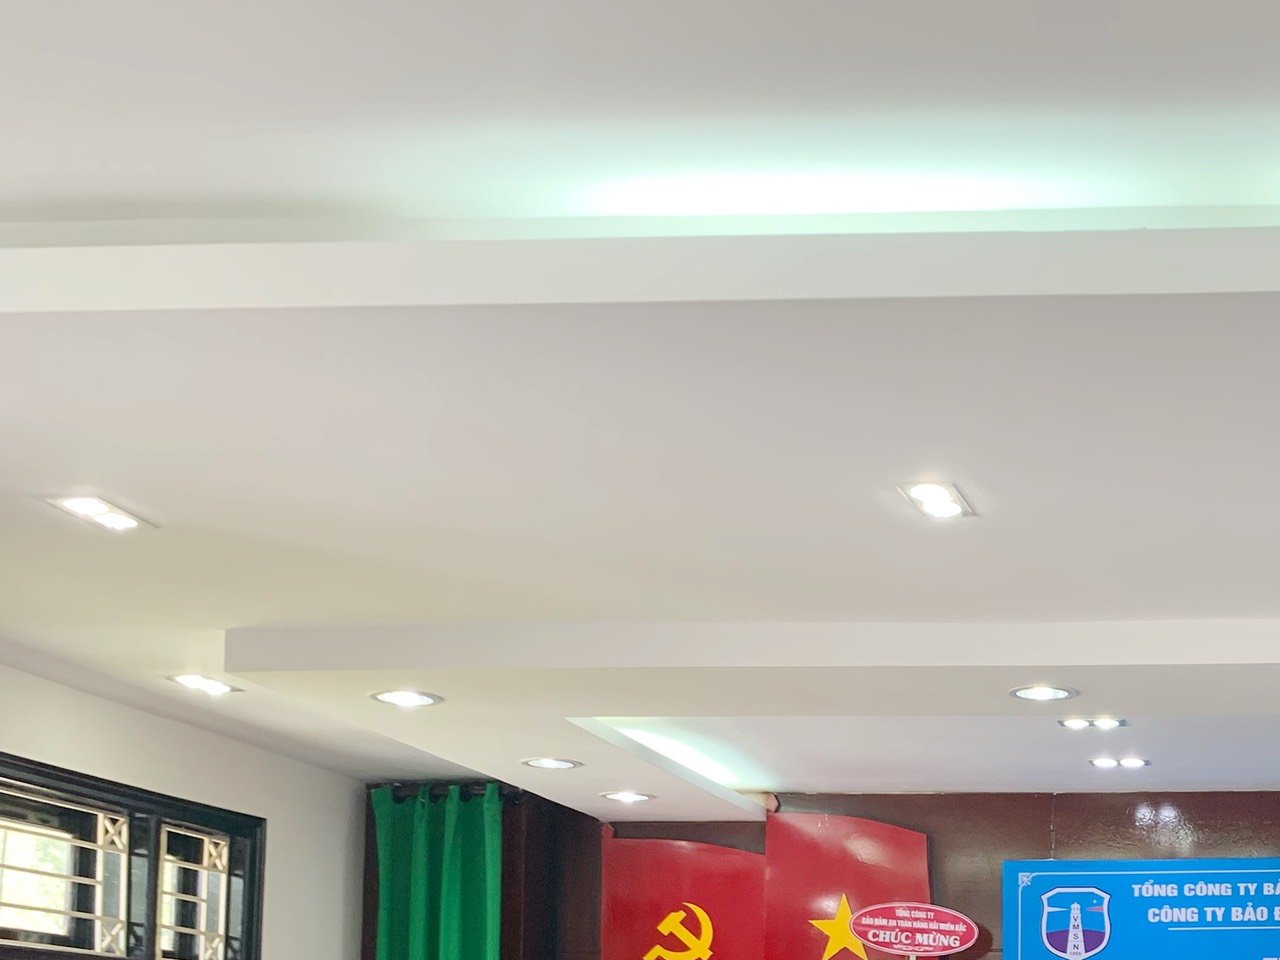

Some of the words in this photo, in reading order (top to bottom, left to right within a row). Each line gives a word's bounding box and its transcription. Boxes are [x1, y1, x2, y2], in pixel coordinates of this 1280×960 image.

[1132, 879, 1178, 897] TỔNG
[1183, 881, 1232, 896] CÔNG
[1237, 882, 1257, 896] TY
[1147, 905, 1199, 923] CÔNG
[1204, 906, 1226, 922] TY
[1231, 901, 1268, 921] BẢO
[867, 929, 912, 944] CHÚC
[915, 931, 960, 947] MỪNG
